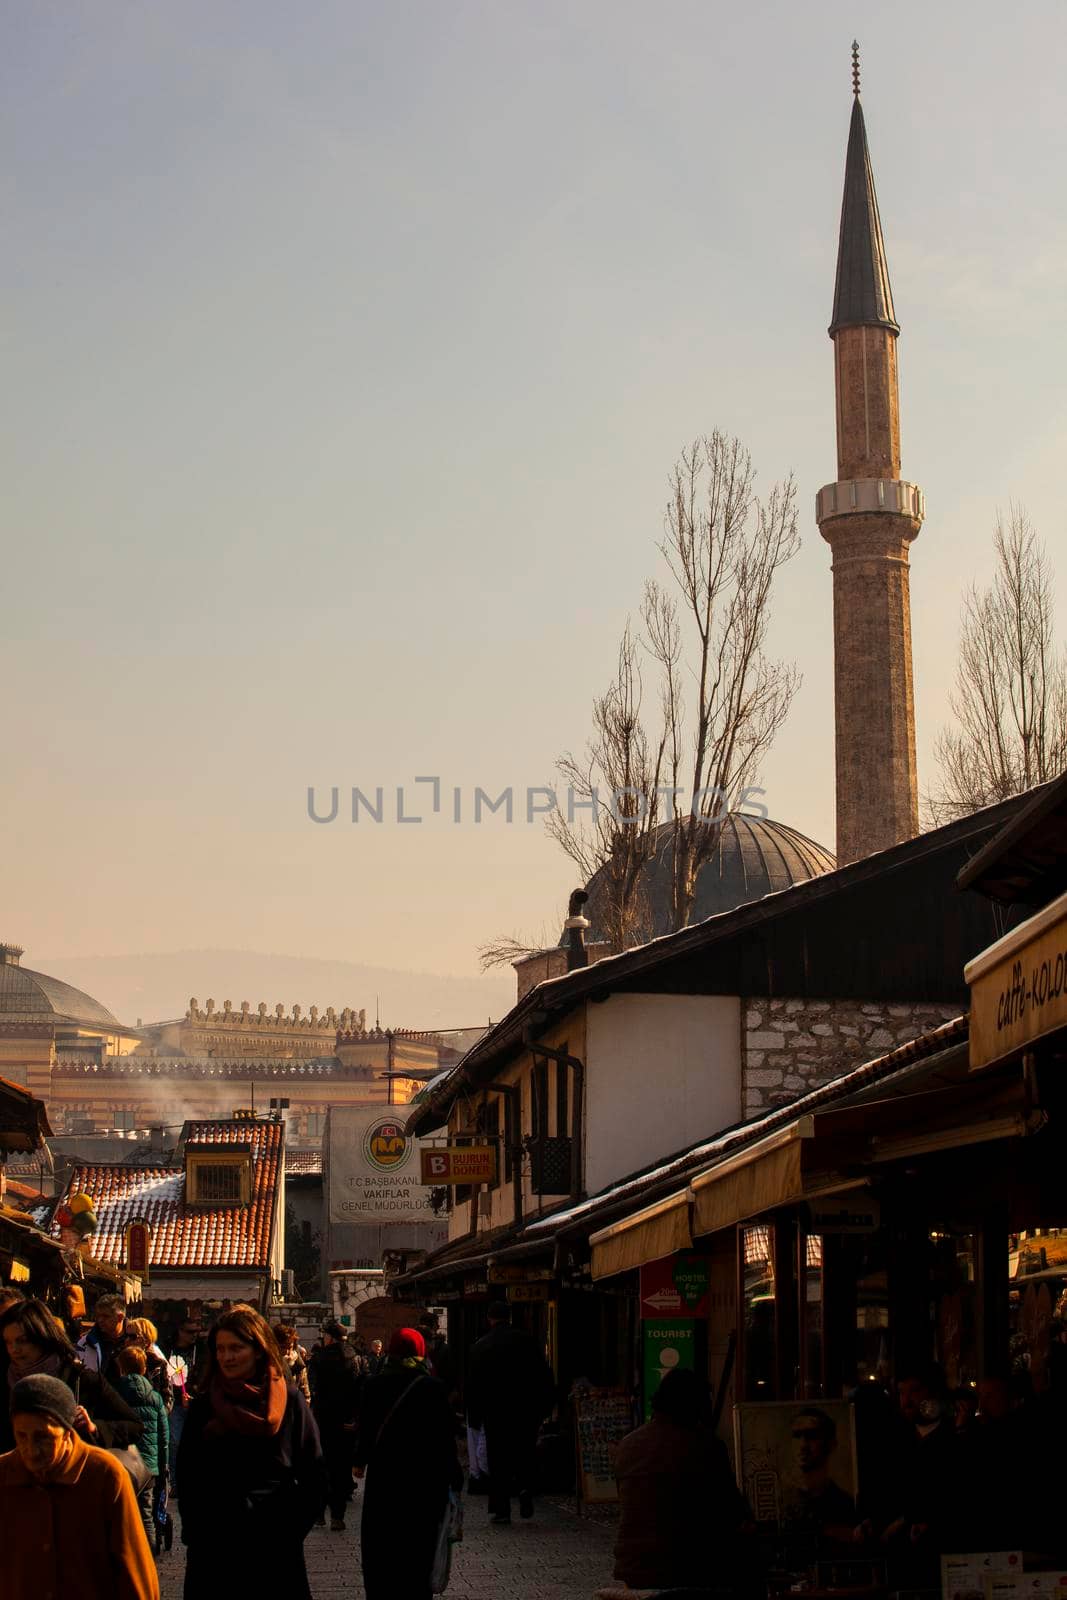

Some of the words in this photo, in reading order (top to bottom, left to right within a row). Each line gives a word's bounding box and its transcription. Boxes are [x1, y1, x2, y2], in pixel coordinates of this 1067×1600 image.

[431, 1156, 447, 1174] B
[363, 1189, 410, 1198] VAKIFLAR
[341, 1201, 373, 1211] GENEL
[647, 1328, 693, 1338] TOURIST
